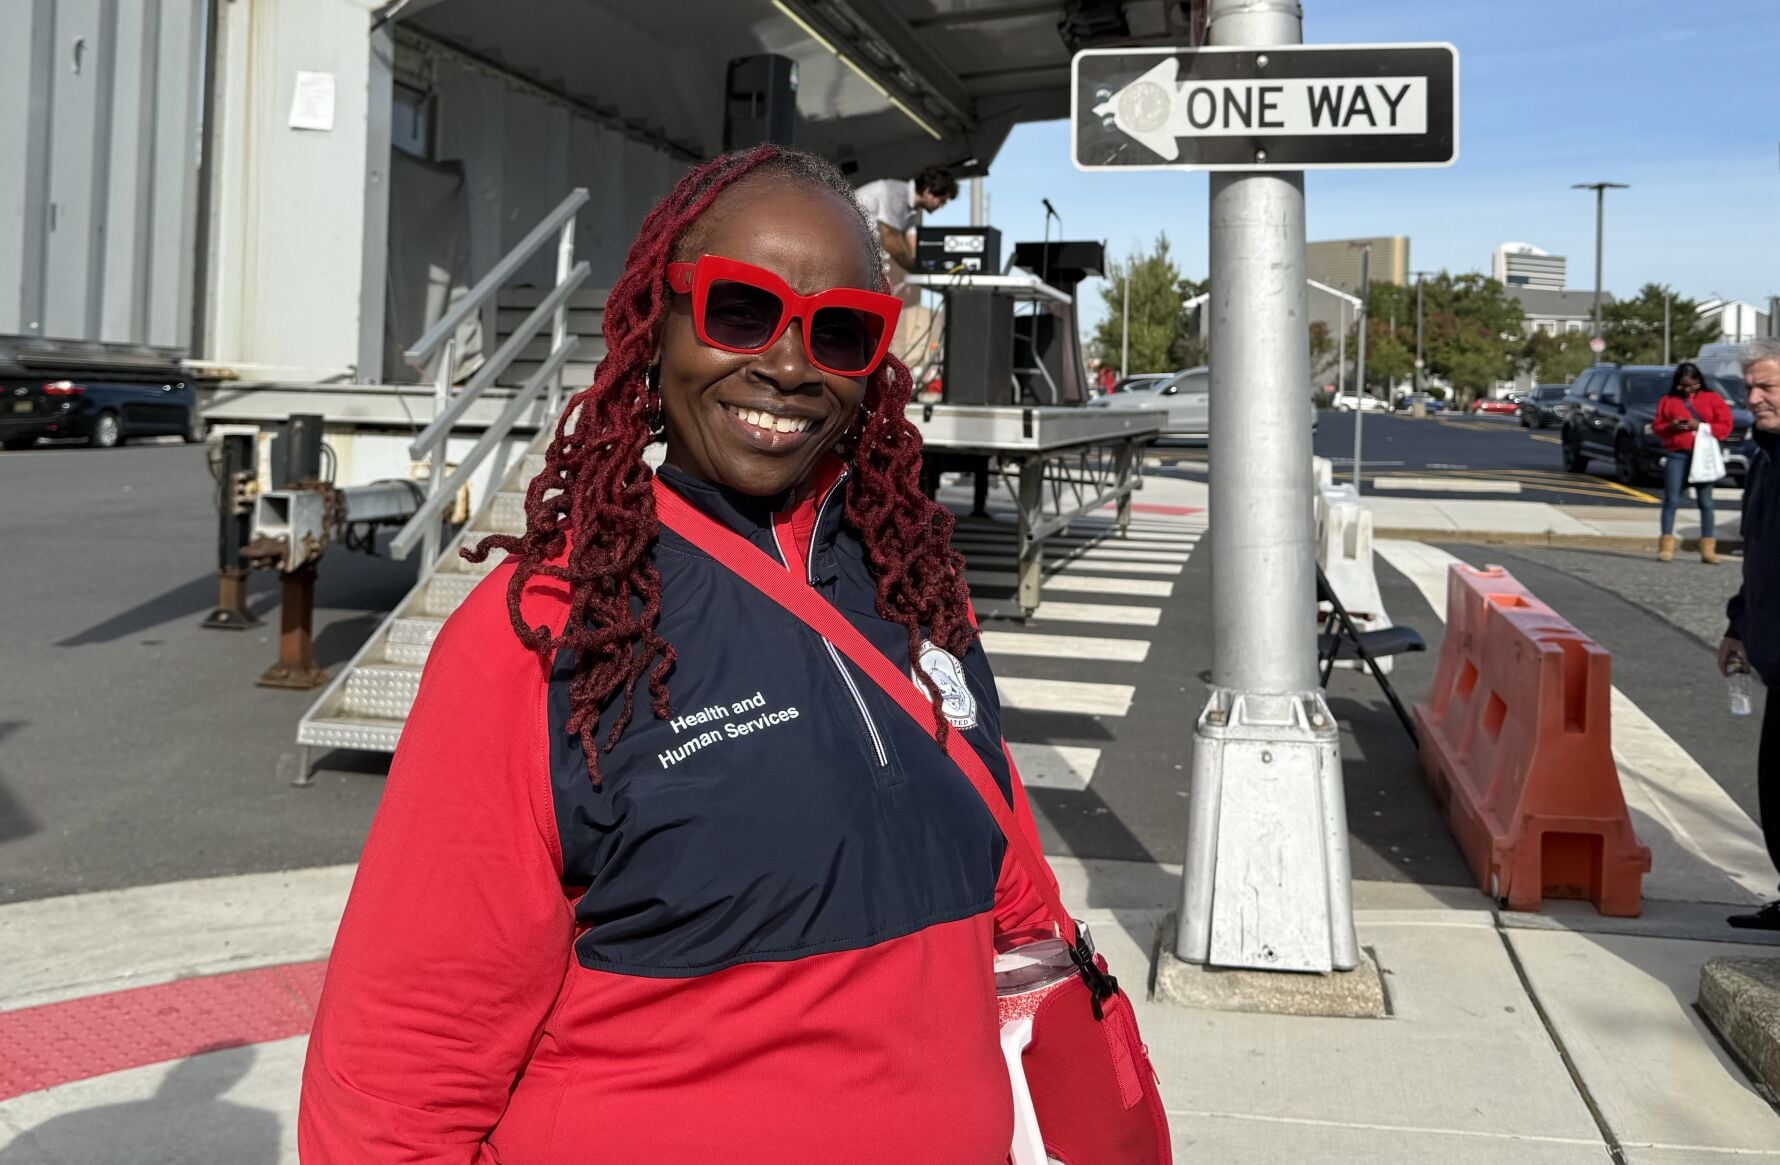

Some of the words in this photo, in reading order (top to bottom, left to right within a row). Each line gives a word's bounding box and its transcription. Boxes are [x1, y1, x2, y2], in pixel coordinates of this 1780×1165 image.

[1187, 86, 1284, 129] ONE
[1307, 84, 1411, 127] WAY
[670, 705, 729, 734] Health
[731, 691, 766, 714] and
[657, 730, 723, 769] Human
[724, 706, 799, 738] Services
